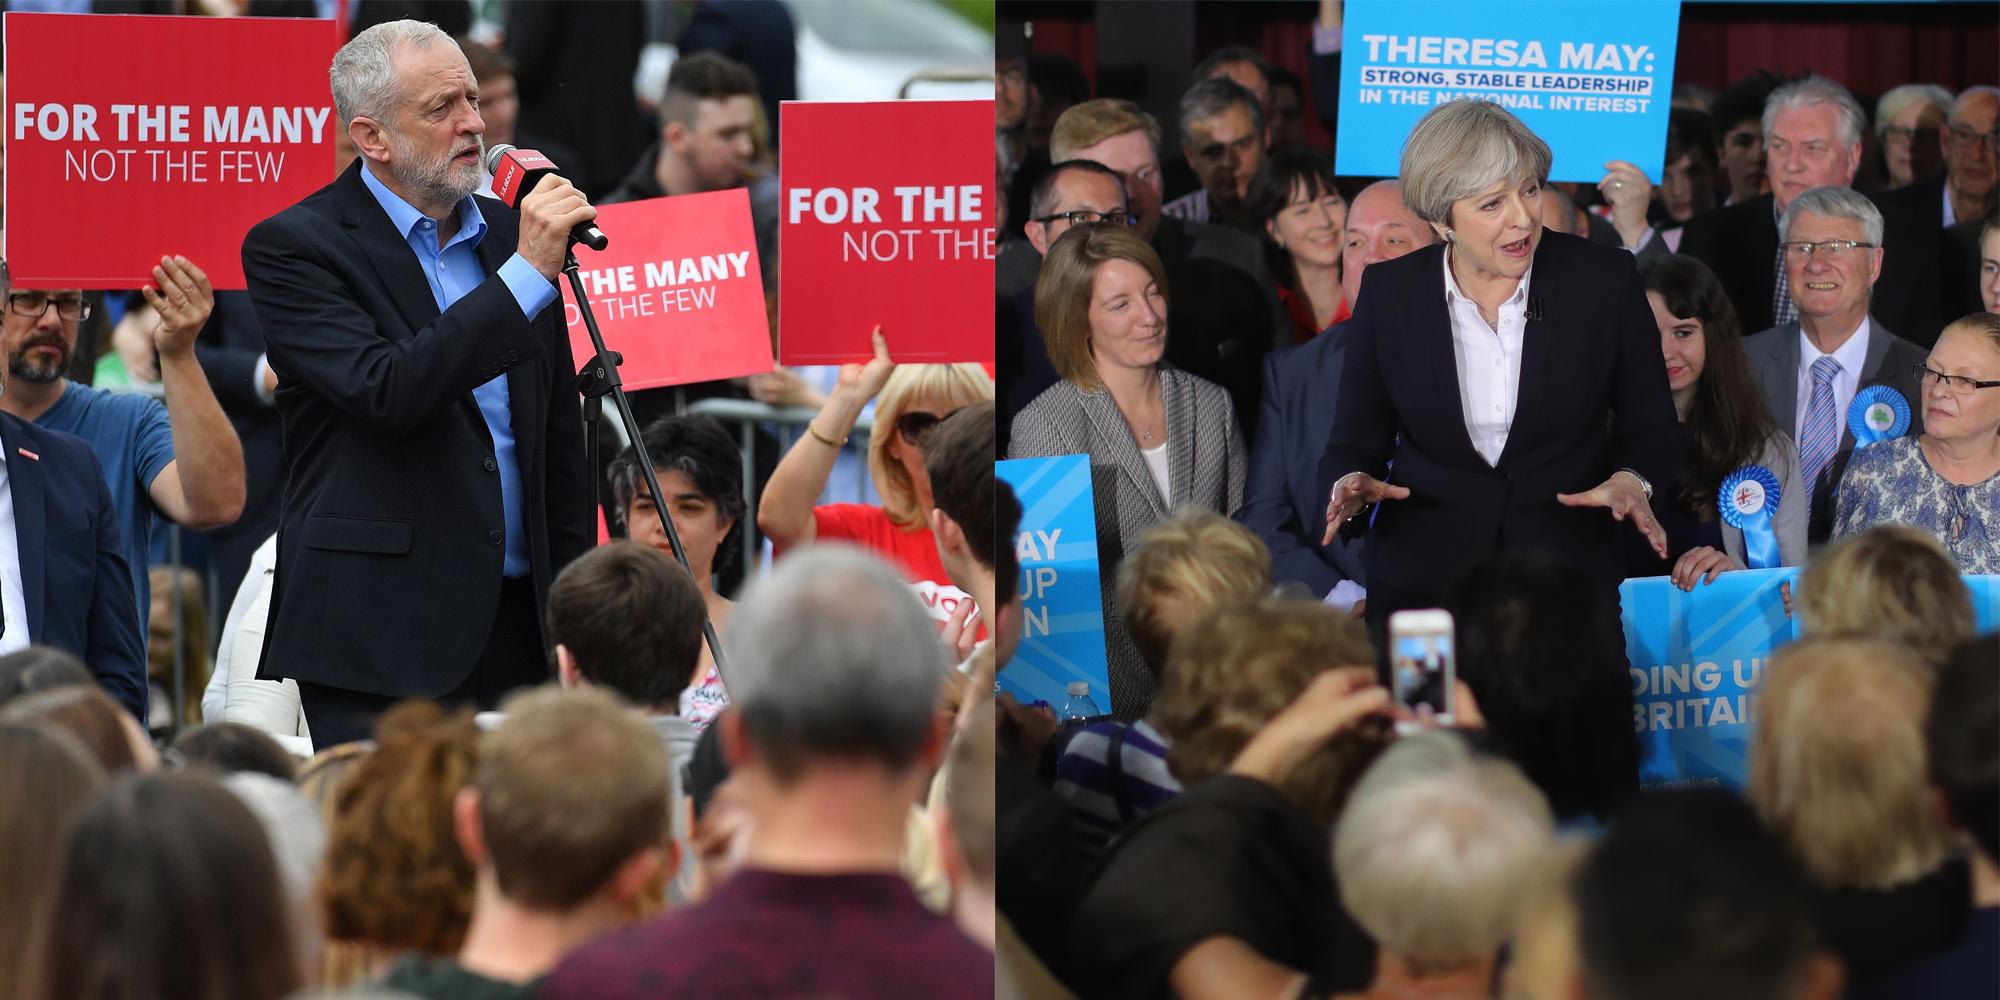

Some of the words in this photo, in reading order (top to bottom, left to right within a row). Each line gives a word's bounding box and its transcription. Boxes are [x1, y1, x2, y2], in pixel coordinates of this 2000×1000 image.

[1363, 34, 1547, 69] THERESA
[1559, 42, 1655, 73] MAY:
[1365, 70, 1449, 87] STRONG,
[1456, 73, 1526, 88] STABLE
[1531, 75, 1649, 93] LEADERSHIP
[1360, 88, 1383, 104] IN
[1388, 90, 1430, 105] THE
[1550, 95, 1650, 113] INTEREST
[15, 103, 100, 141] FOR
[112, 105, 190, 142] THE
[203, 106, 331, 144] MANY
[65, 149, 137, 182] NOT
[145, 151, 207, 182] THE
[220, 151, 285, 183] FEW
[789, 187, 882, 224] FOR
[894, 185, 982, 222] THE
[843, 229, 922, 262] NOT
[930, 228, 995, 260] THE
[579, 266, 636, 296] THE
[643, 251, 750, 289] MANY
[602, 293, 655, 321] THE
[662, 286, 716, 313] FEW
[1024, 605, 1050, 638] N
[1733, 657, 1763, 689] U
[1633, 694, 1750, 733] BRITAI
